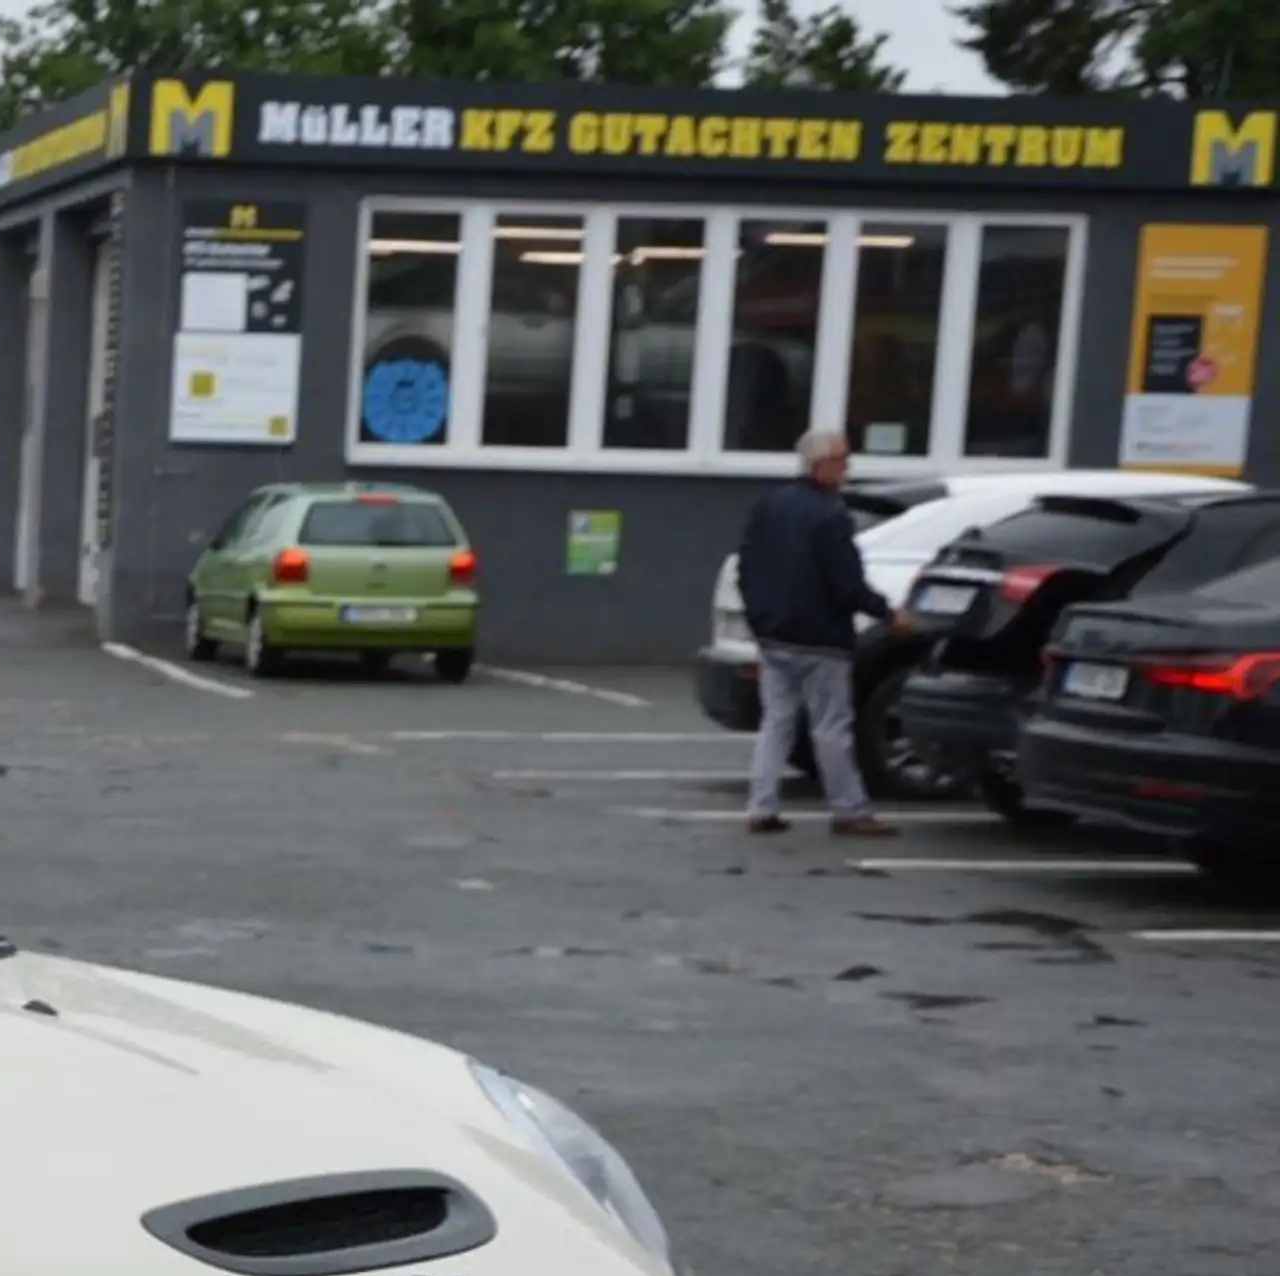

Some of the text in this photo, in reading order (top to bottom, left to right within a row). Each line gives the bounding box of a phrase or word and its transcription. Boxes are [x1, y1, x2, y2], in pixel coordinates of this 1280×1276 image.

[149, 79, 235, 156] M
[461, 108, 555, 151] KFZ
[569, 112, 862, 160] GUTACHTEN
[884, 121, 1124, 168] ZENTRUM
[1189, 110, 1277, 186] M
